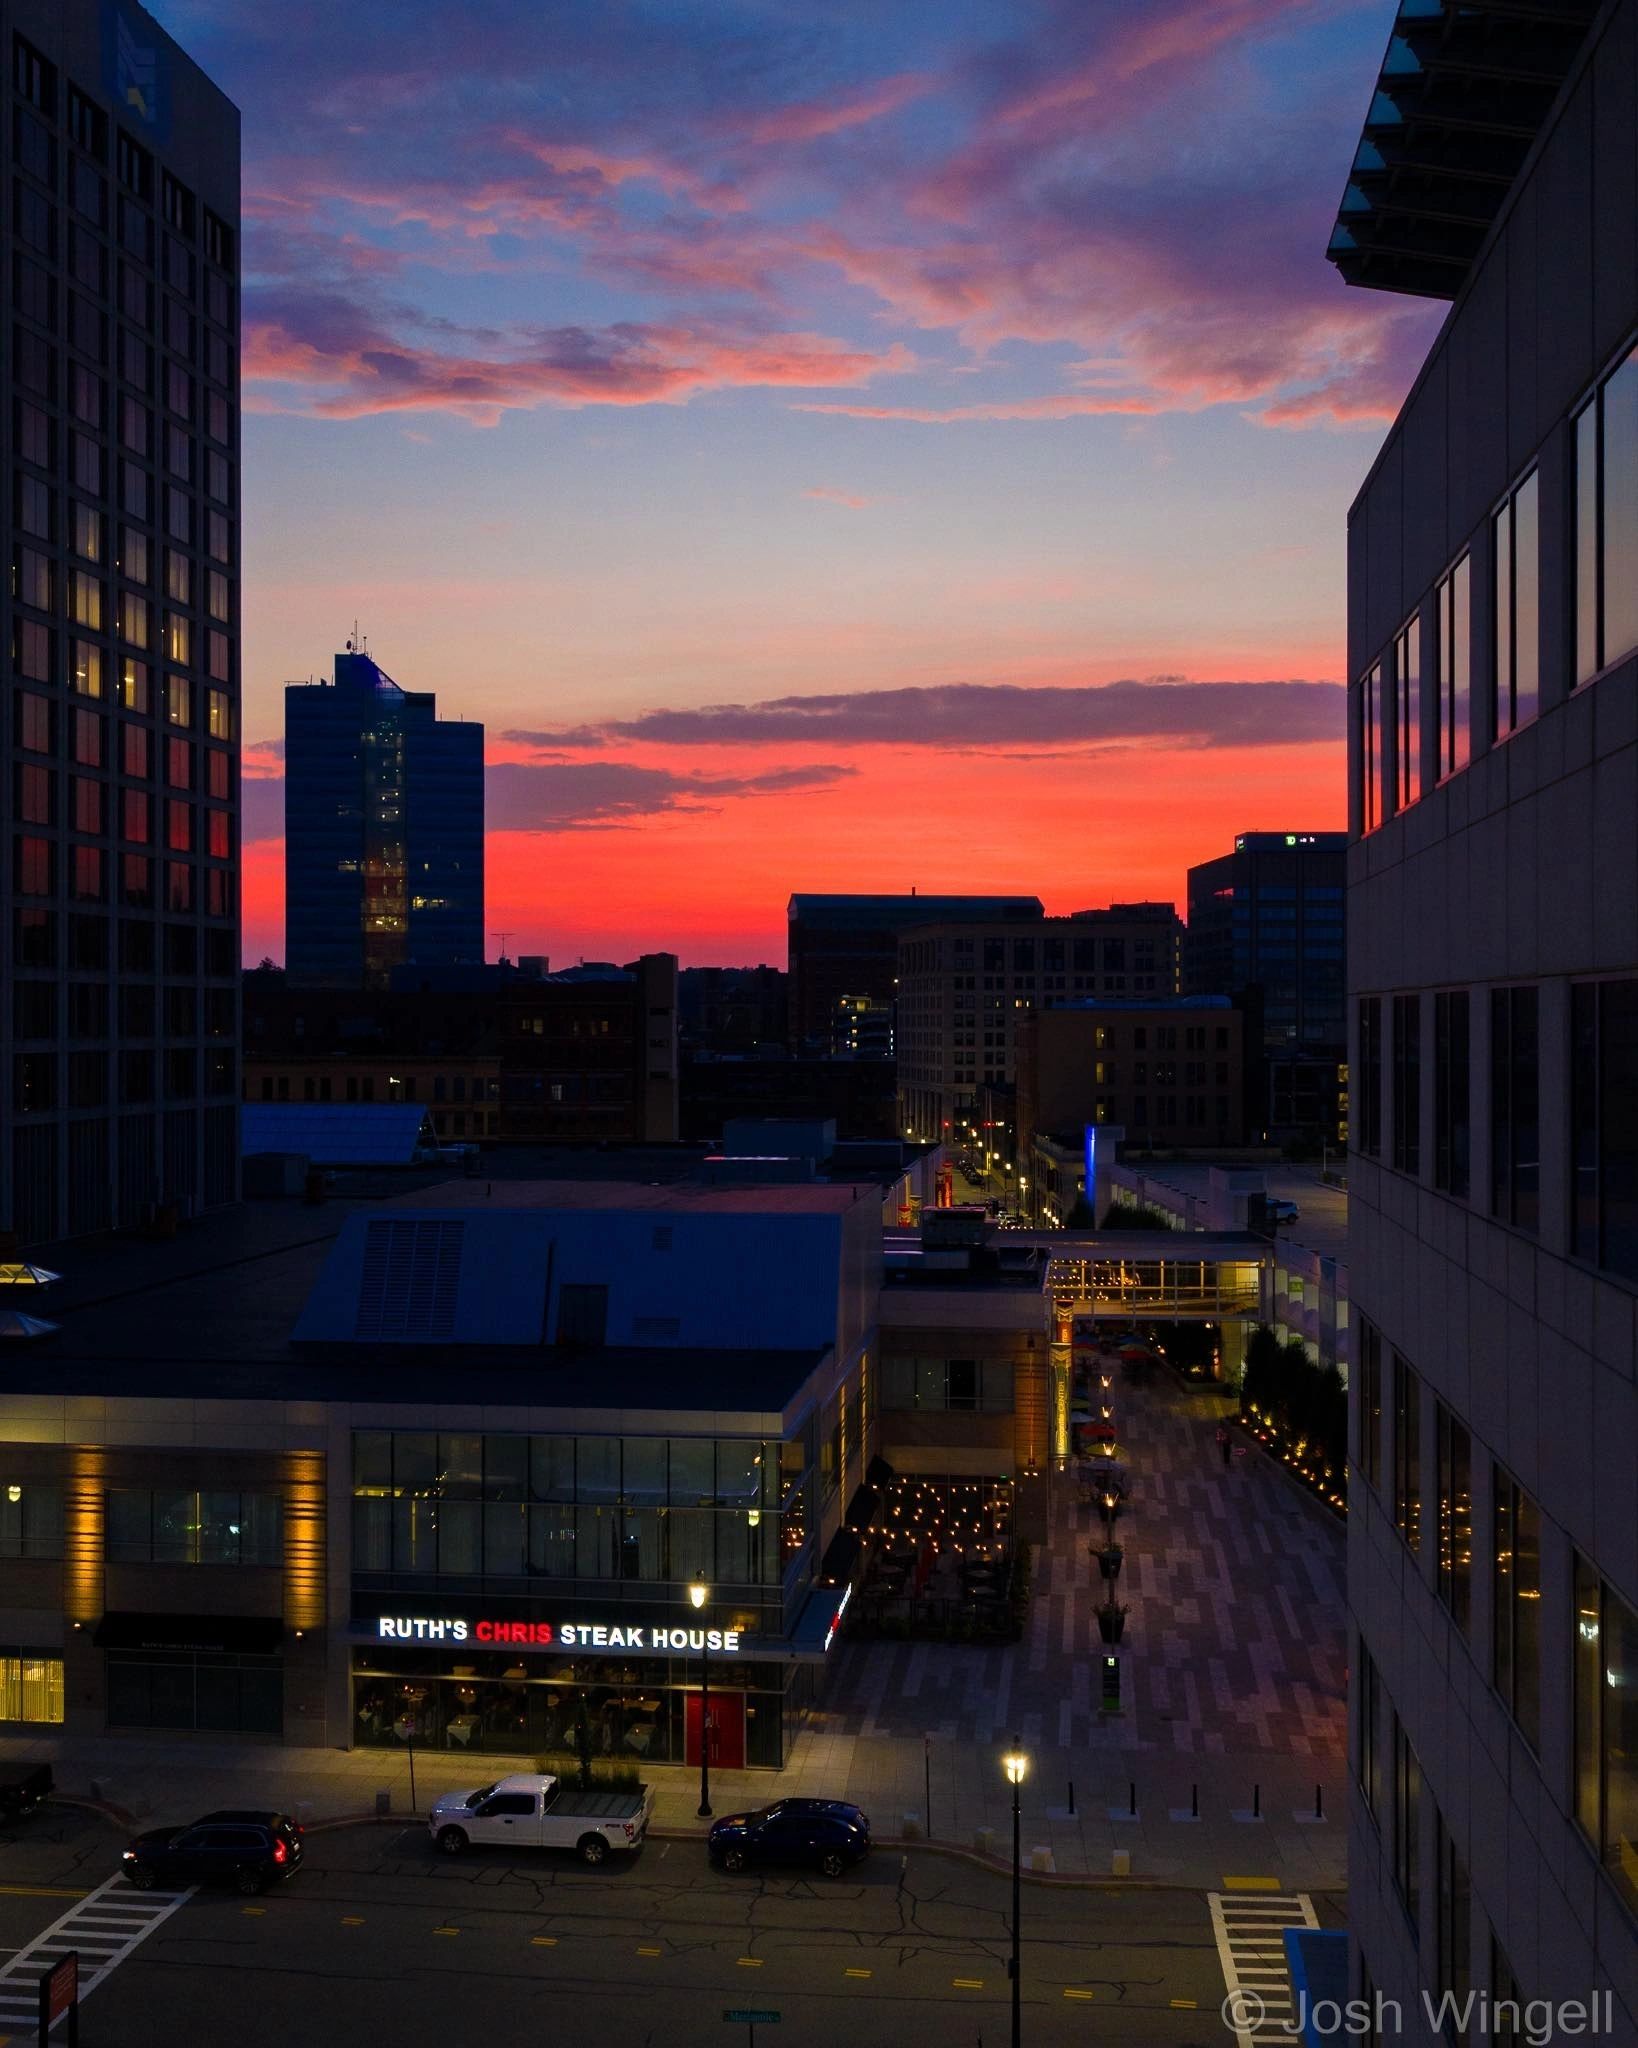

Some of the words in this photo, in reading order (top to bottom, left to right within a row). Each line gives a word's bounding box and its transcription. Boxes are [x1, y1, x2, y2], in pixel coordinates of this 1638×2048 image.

[379, 1617, 468, 1640] RUTH'S
[476, 1621, 552, 1645] CHRIS
[560, 1625, 644, 1648] STEAK
[652, 1629, 740, 1652] HOUSE
